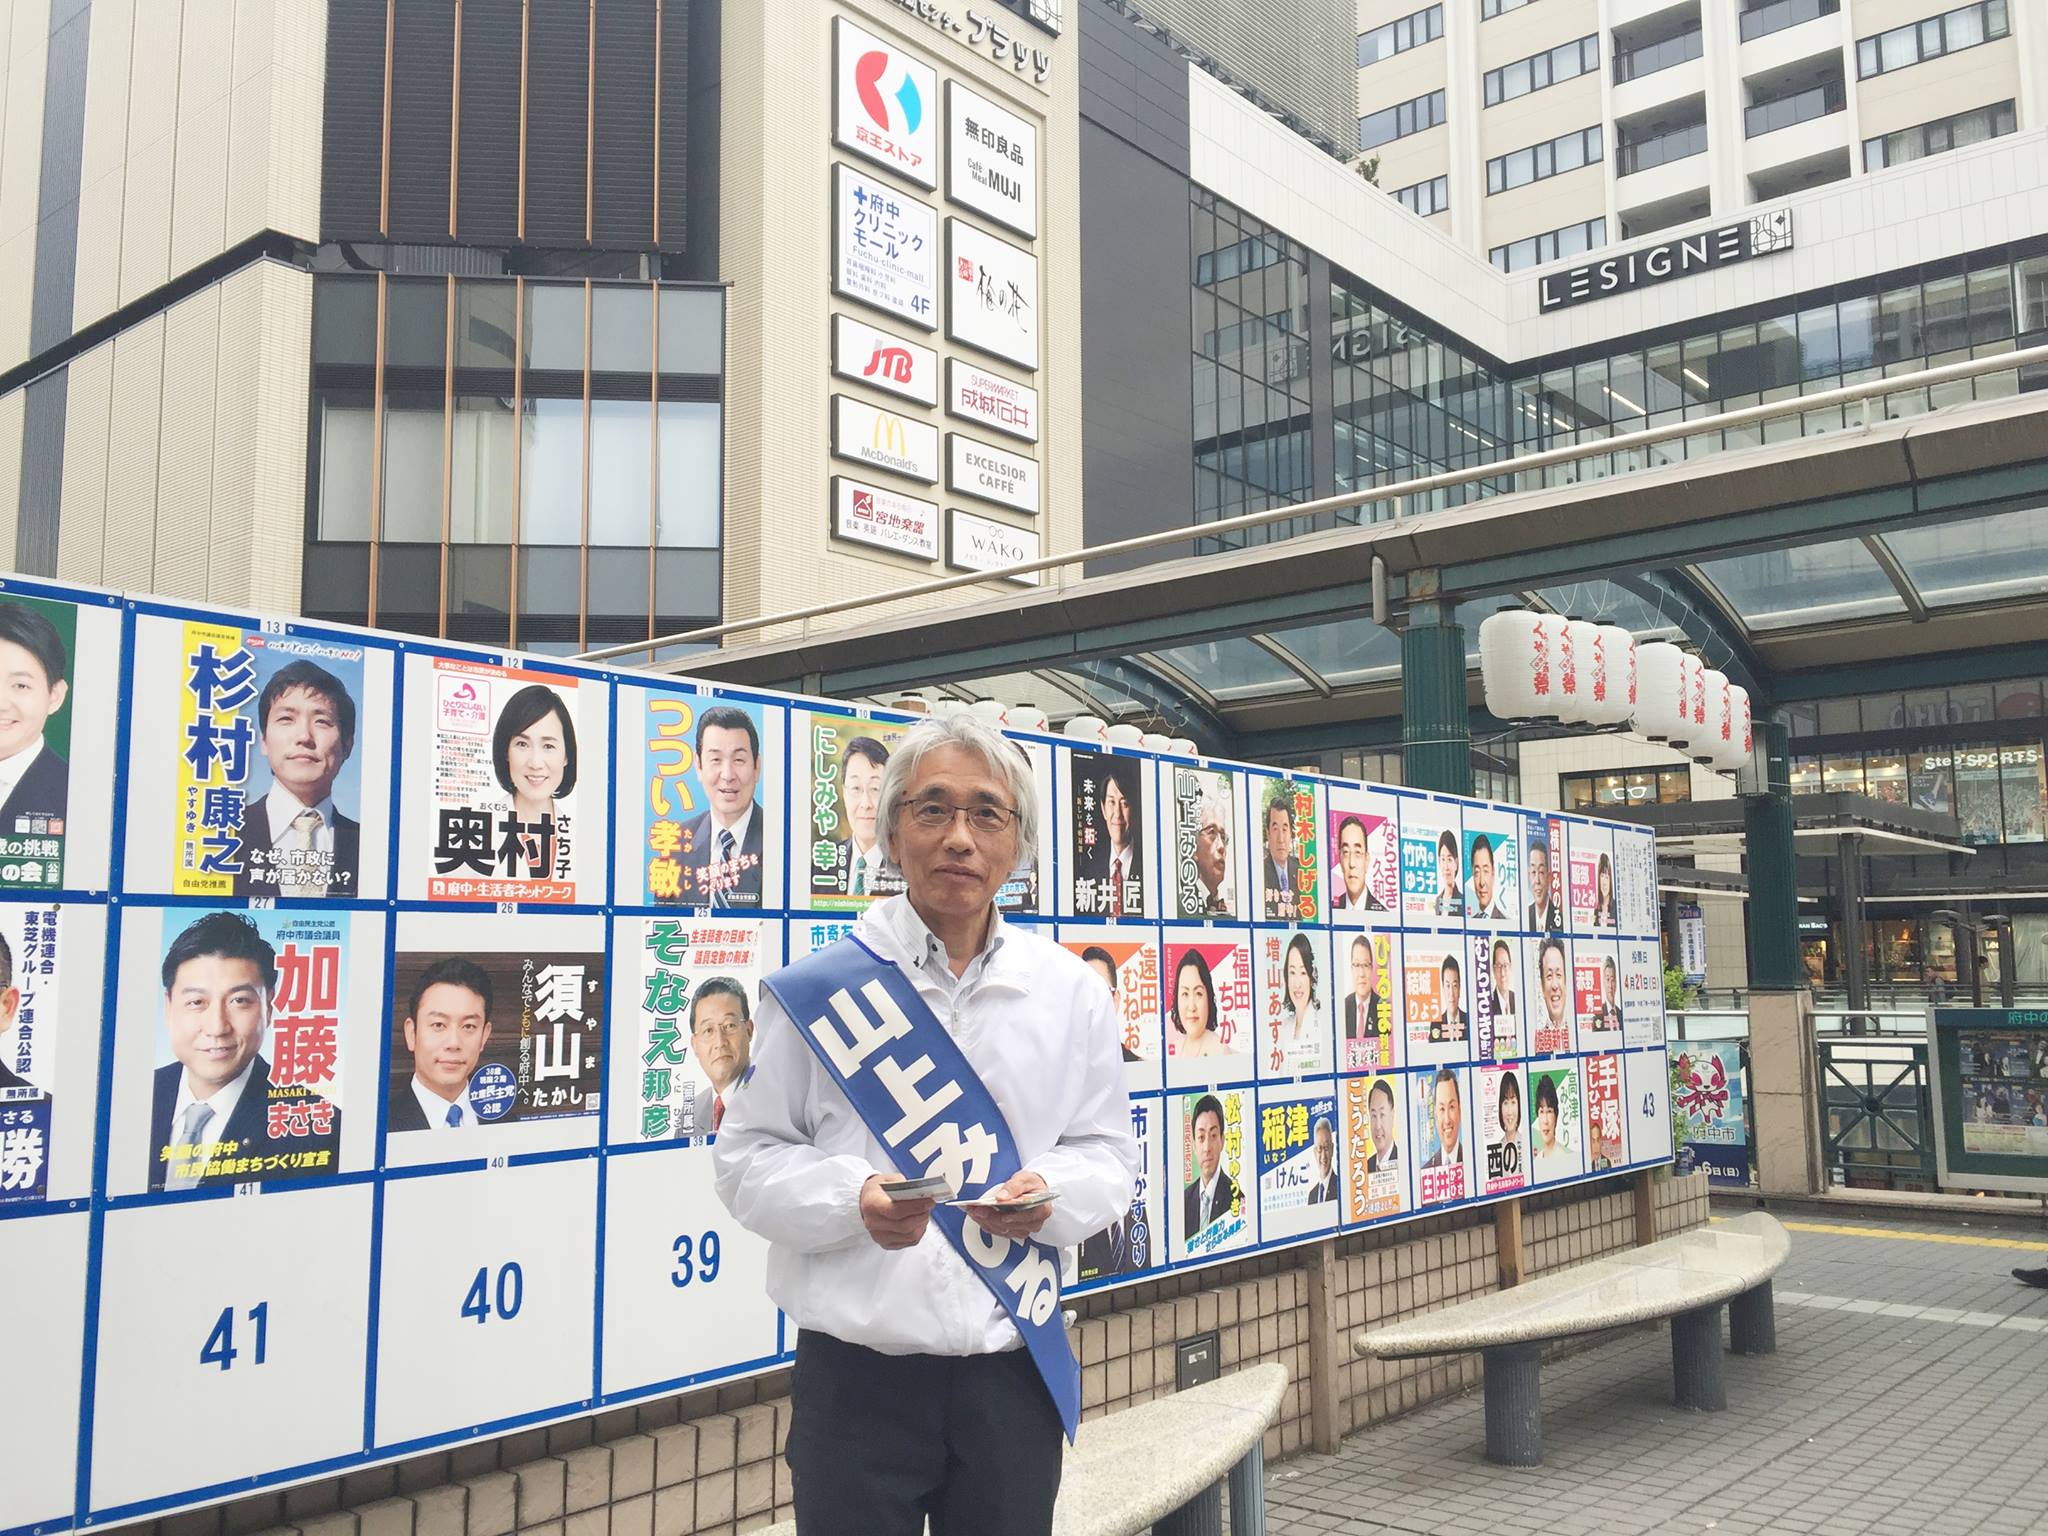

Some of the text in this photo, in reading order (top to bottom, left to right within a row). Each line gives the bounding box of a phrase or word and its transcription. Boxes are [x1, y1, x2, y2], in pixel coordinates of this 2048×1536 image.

[966, 9, 1052, 84] プラッツ
[855, 125, 922, 167] 京王ストア
[965, 117, 1024, 166] 無印良品
[988, 169, 1021, 202] MUJI
[870, 194, 900, 218] 府中
[853, 208, 923, 251] クリニック
[853, 228, 900, 259] モール
[1543, 227, 1739, 306] LESIGNE
[911, 295, 930, 315] 4F
[863, 347, 913, 384] JTB
[971, 374, 1019, 401] SUPERMARKET
[962, 387, 1029, 428] 成城石井
[861, 445, 918, 473] McDonald's
[965, 453, 1026, 482] EXCELSIOR
[979, 473, 1015, 494] CAFFÉ
[875, 511, 925, 535] 宮地楽器
[972, 535, 1024, 561] WAKO
[266, 620, 280, 634] 13
[507, 658, 519, 669] 12
[442, 700, 487, 712] ひとりにしない
[185, 644, 258, 876] 杉村康之
[1925, 749, 2039, 771] Step SPORTS
[185, 786, 198, 833] やすゆき
[479, 803, 508, 812] おくむら
[647, 698, 695, 897] つつい孝敏
[250, 848, 335, 866] なぜ、市政に
[434, 807, 555, 879] 奥村
[556, 814, 572, 879] さち子
[1177, 770, 1199, 914] 山上みのる
[1294, 792, 1316, 919] 村木しげる
[1403, 841, 1427, 867] 竹内
[249, 868, 351, 886] 声が届かない?
[1383, 819, 1398, 910] ならさき
[1405, 870, 1437, 892] ゆう子
[1506, 838, 1517, 888] 西村
[1550, 828, 1562, 927] 横田みのる
[254, 896, 270, 908] 27
[502, 902, 513, 914] 26
[1075, 876, 1142, 914] 新井匠
[1573, 889, 1596, 908] ひとみ
[276, 929, 341, 941] 府中市議会議員
[15, 911, 40, 1074] 東芝グループ連合公認
[1139, 948, 1158, 1014] 遠田
[1233, 948, 1250, 1010] 福田
[269, 944, 340, 1087] 加藤
[534, 963, 585, 1081] 須山
[1123, 967, 1140, 1050] むねお
[1219, 981, 1237, 1045] ちか
[1266, 936, 1284, 1071] 増山あすか
[1409, 998, 1440, 1021] りょう
[643, 920, 690, 1139] そなえ邦彦
[6, 1087, 39, 1099] 無所属
[268, 1088, 306, 1098] MASAKI
[482, 1102, 502, 1114] 公認
[532, 1085, 583, 1107] たかし
[1587, 1057, 1601, 1121] としひさ
[1599, 1057, 1620, 1140] 手塚
[1642, 1092, 1655, 1118] 43
[0, 1110, 34, 1125] さる
[267, 1100, 335, 1139] まさき
[1262, 1103, 1310, 1151] 稲津
[693, 1136, 704, 1147] 39
[1225, 1093, 1242, 1217] 松村ゆうき
[1349, 1079, 1366, 1216] こうたろう
[175, 1150, 332, 1178] 市民協働まちづくり宣言
[491, 1156, 504, 1168] 40
[1487, 1142, 1518, 1180] 西の
[239, 1184, 254, 1196] 41
[671, 1230, 722, 1289] 39
[460, 1261, 524, 1325] 40
[200, 1301, 268, 1371] 41
